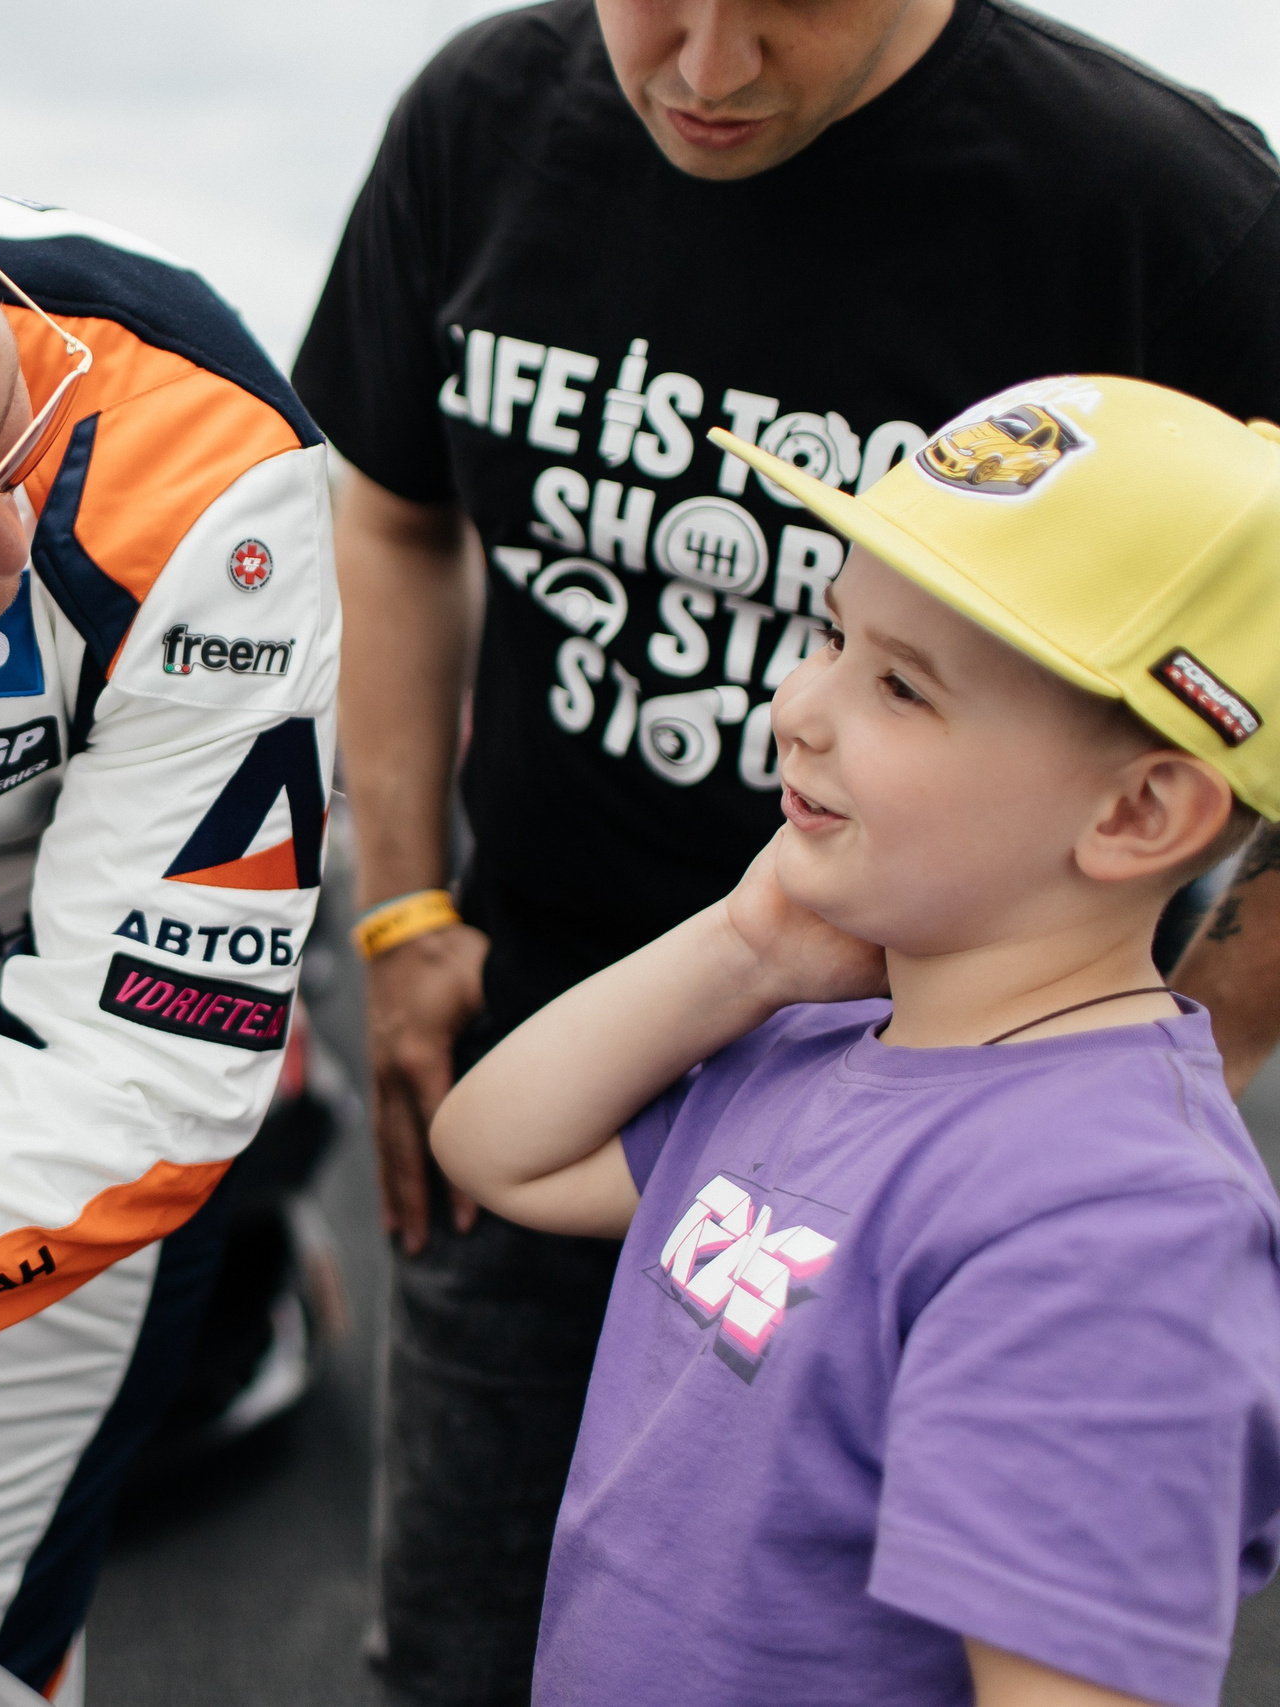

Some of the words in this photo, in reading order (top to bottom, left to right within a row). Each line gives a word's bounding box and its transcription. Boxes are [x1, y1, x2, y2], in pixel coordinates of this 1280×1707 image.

[528, 466, 844, 622] SHOR
[165, 626, 290, 673] freem
[647, 577, 832, 691] STA
[1168, 668, 1245, 738] RACING
[1172, 655, 1259, 734] FORWARD
[111, 909, 303, 967] АВТОБ
